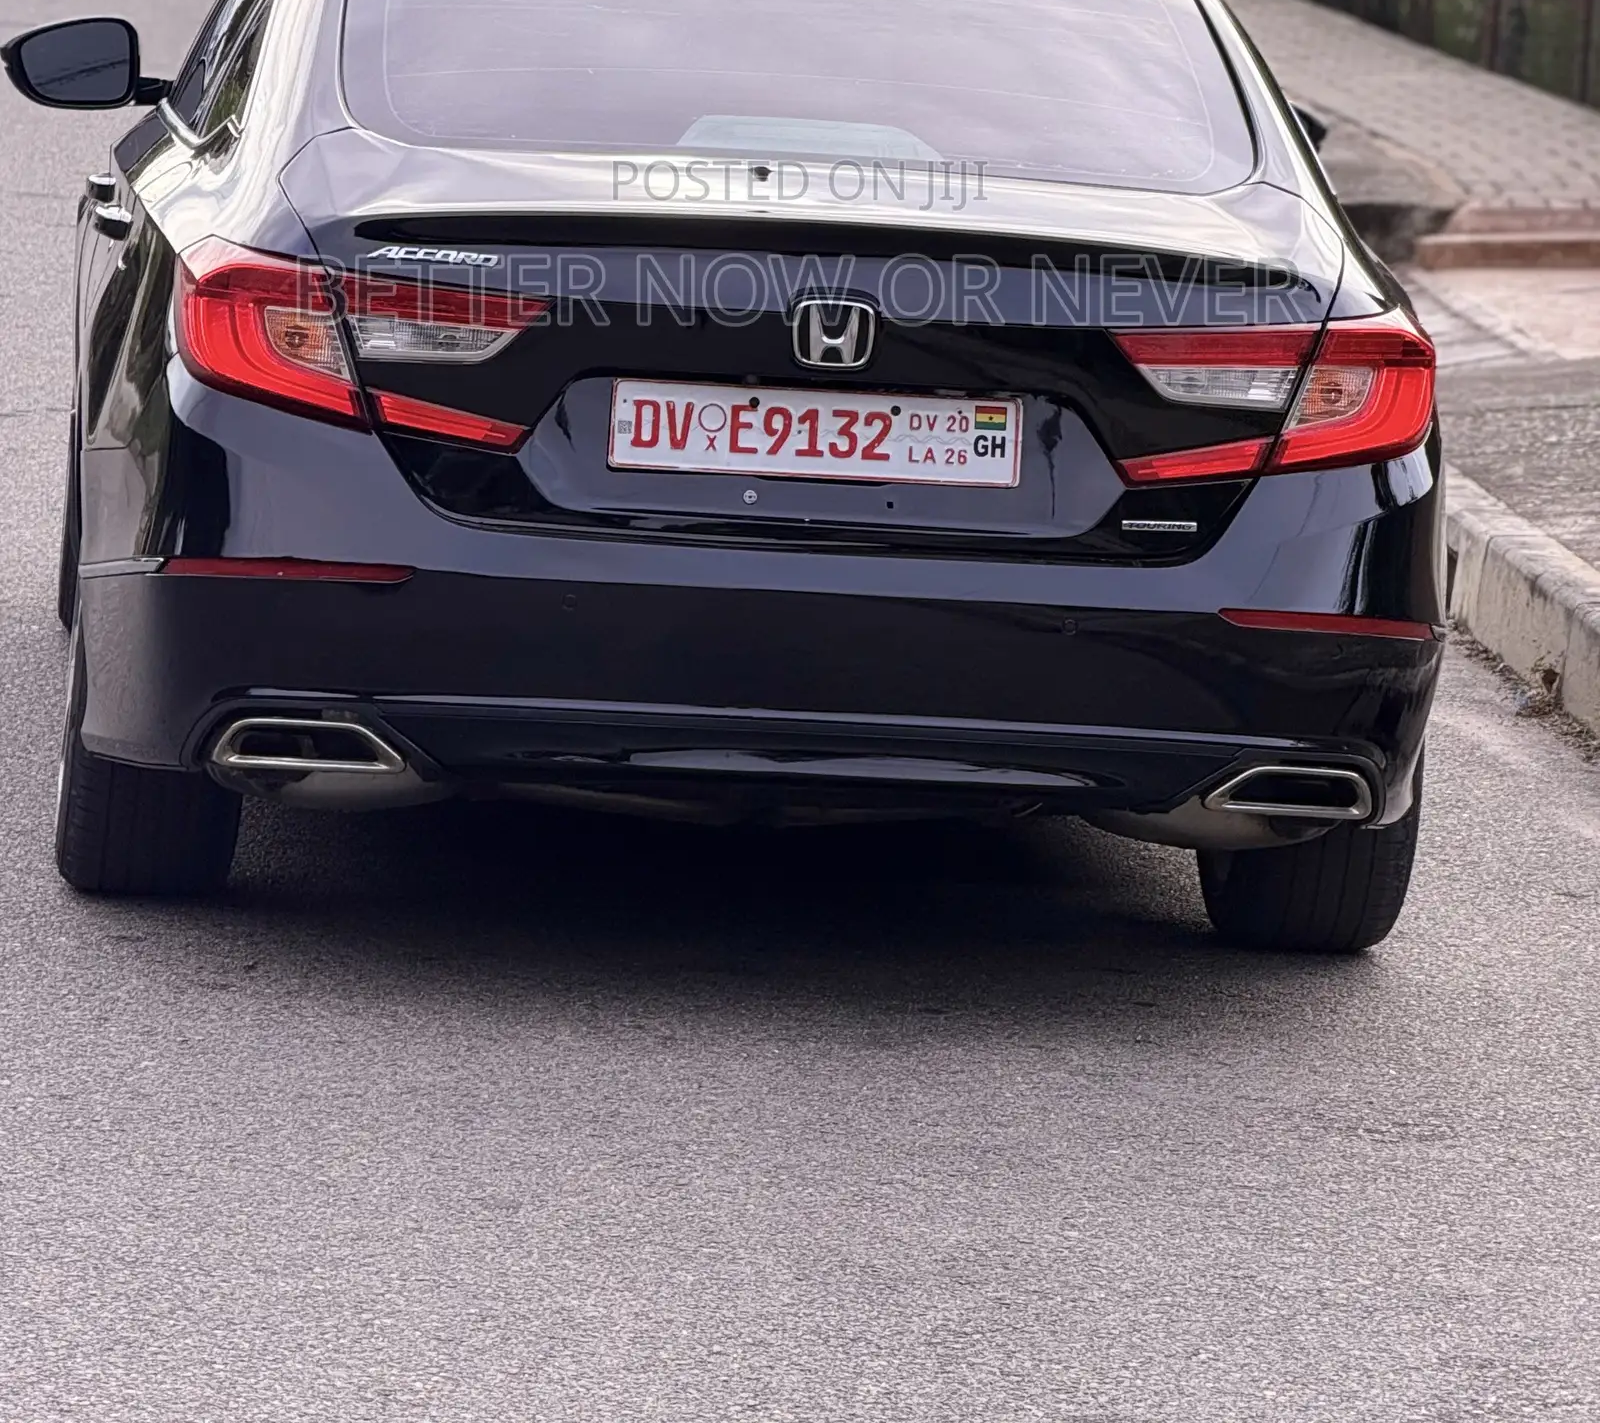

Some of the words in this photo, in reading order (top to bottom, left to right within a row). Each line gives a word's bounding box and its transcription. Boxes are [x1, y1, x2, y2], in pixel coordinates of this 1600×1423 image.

[367, 246, 499, 267] ACCORD
[630, 399, 695, 450] DV
[729, 404, 893, 462] E9132
[909, 413, 938, 432] DV
[946, 415, 970, 433] 20
[908, 446, 937, 465] LA
[945, 448, 968, 465] 26
[973, 435, 1006, 459] GH
